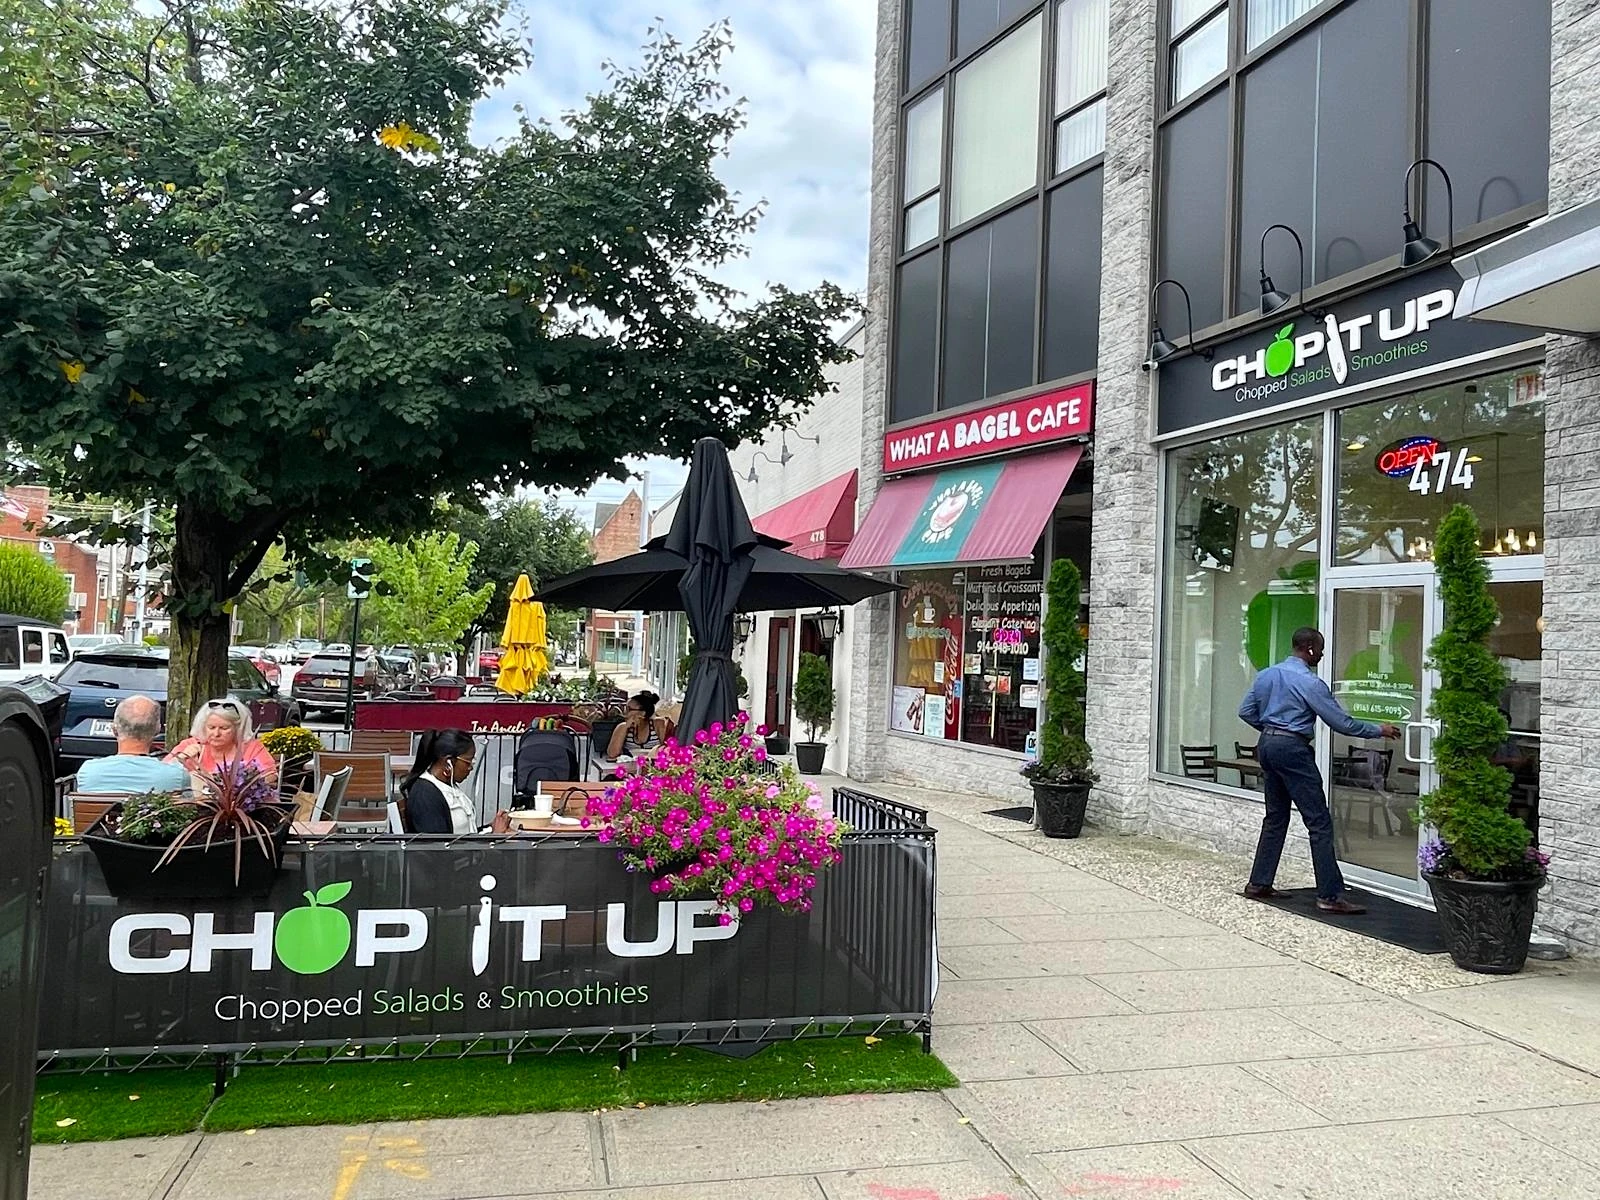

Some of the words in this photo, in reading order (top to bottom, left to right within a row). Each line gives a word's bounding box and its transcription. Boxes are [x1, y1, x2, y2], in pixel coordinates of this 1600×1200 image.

[1212, 322, 1324, 391] CHOP
[1379, 289, 1454, 341] UP
[1235, 375, 1287, 402] Chopped
[1290, 364, 1331, 388] Salads
[1351, 339, 1428, 371] Smoothies
[890, 431, 935, 462] WHAT
[937, 429, 949, 453] A
[954, 410, 1021, 449] BAGEL
[1026, 398, 1081, 433] CAFE
[1380, 443, 1438, 471] OPEN
[1408, 447, 1474, 495] 474
[810, 529, 825, 543] 478
[981, 565, 1003, 576] Fresh
[1005, 564, 1031, 579] Bagels
[967, 583, 996, 593] Muffins
[966, 600, 1000, 611] Delicious
[1002, 617, 1037, 633] Catering
[1367, 671, 1389, 680] Hours
[1353, 703, 1369, 713] (914)
[471, 720, 488, 733] Tre
[108, 881, 429, 975] CHOP
[606, 900, 740, 958] UP
[214, 990, 363, 1024] Chopped
[372, 986, 465, 1014] Salads
[477, 992, 491, 1009] &
[500, 982, 649, 1010] Smoothies
